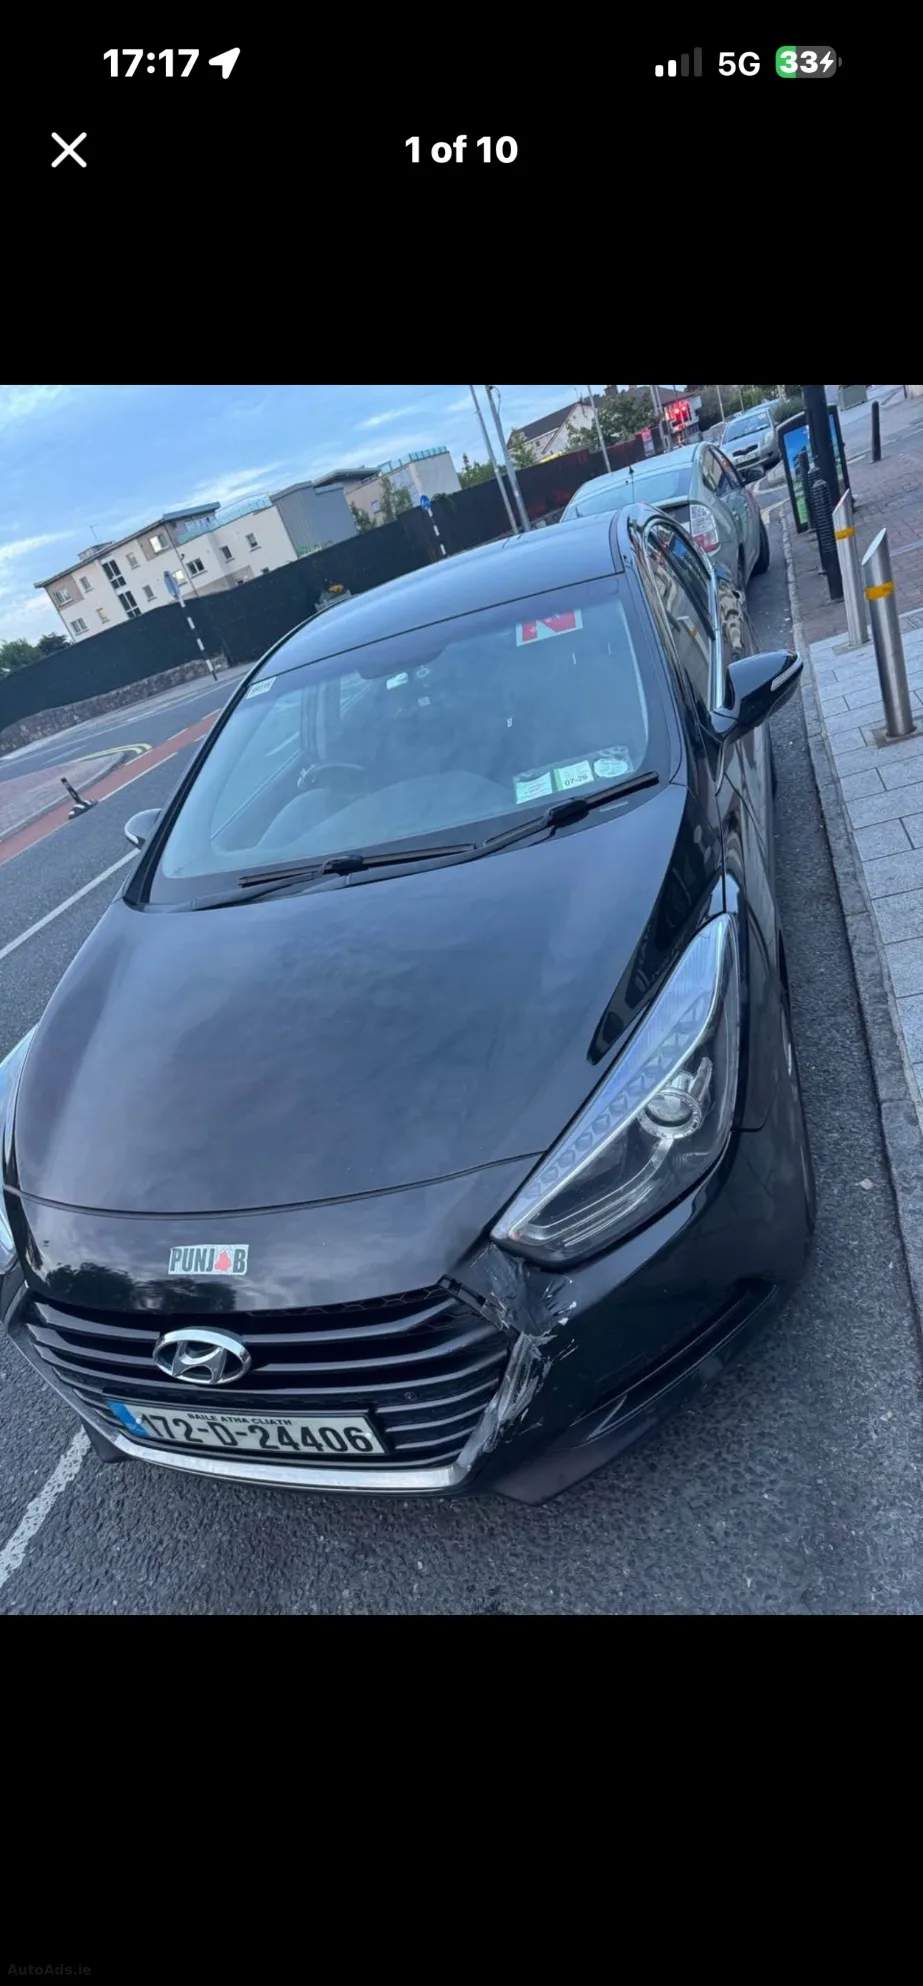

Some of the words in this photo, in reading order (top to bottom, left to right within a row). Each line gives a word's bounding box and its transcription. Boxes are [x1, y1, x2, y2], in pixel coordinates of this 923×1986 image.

[169, 1247, 247, 1273] PUNJB
[187, 1413, 219, 1421] BAILE
[251, 1418, 292, 1426] CLIATH
[140, 1413, 374, 1453] 172-D-24406
